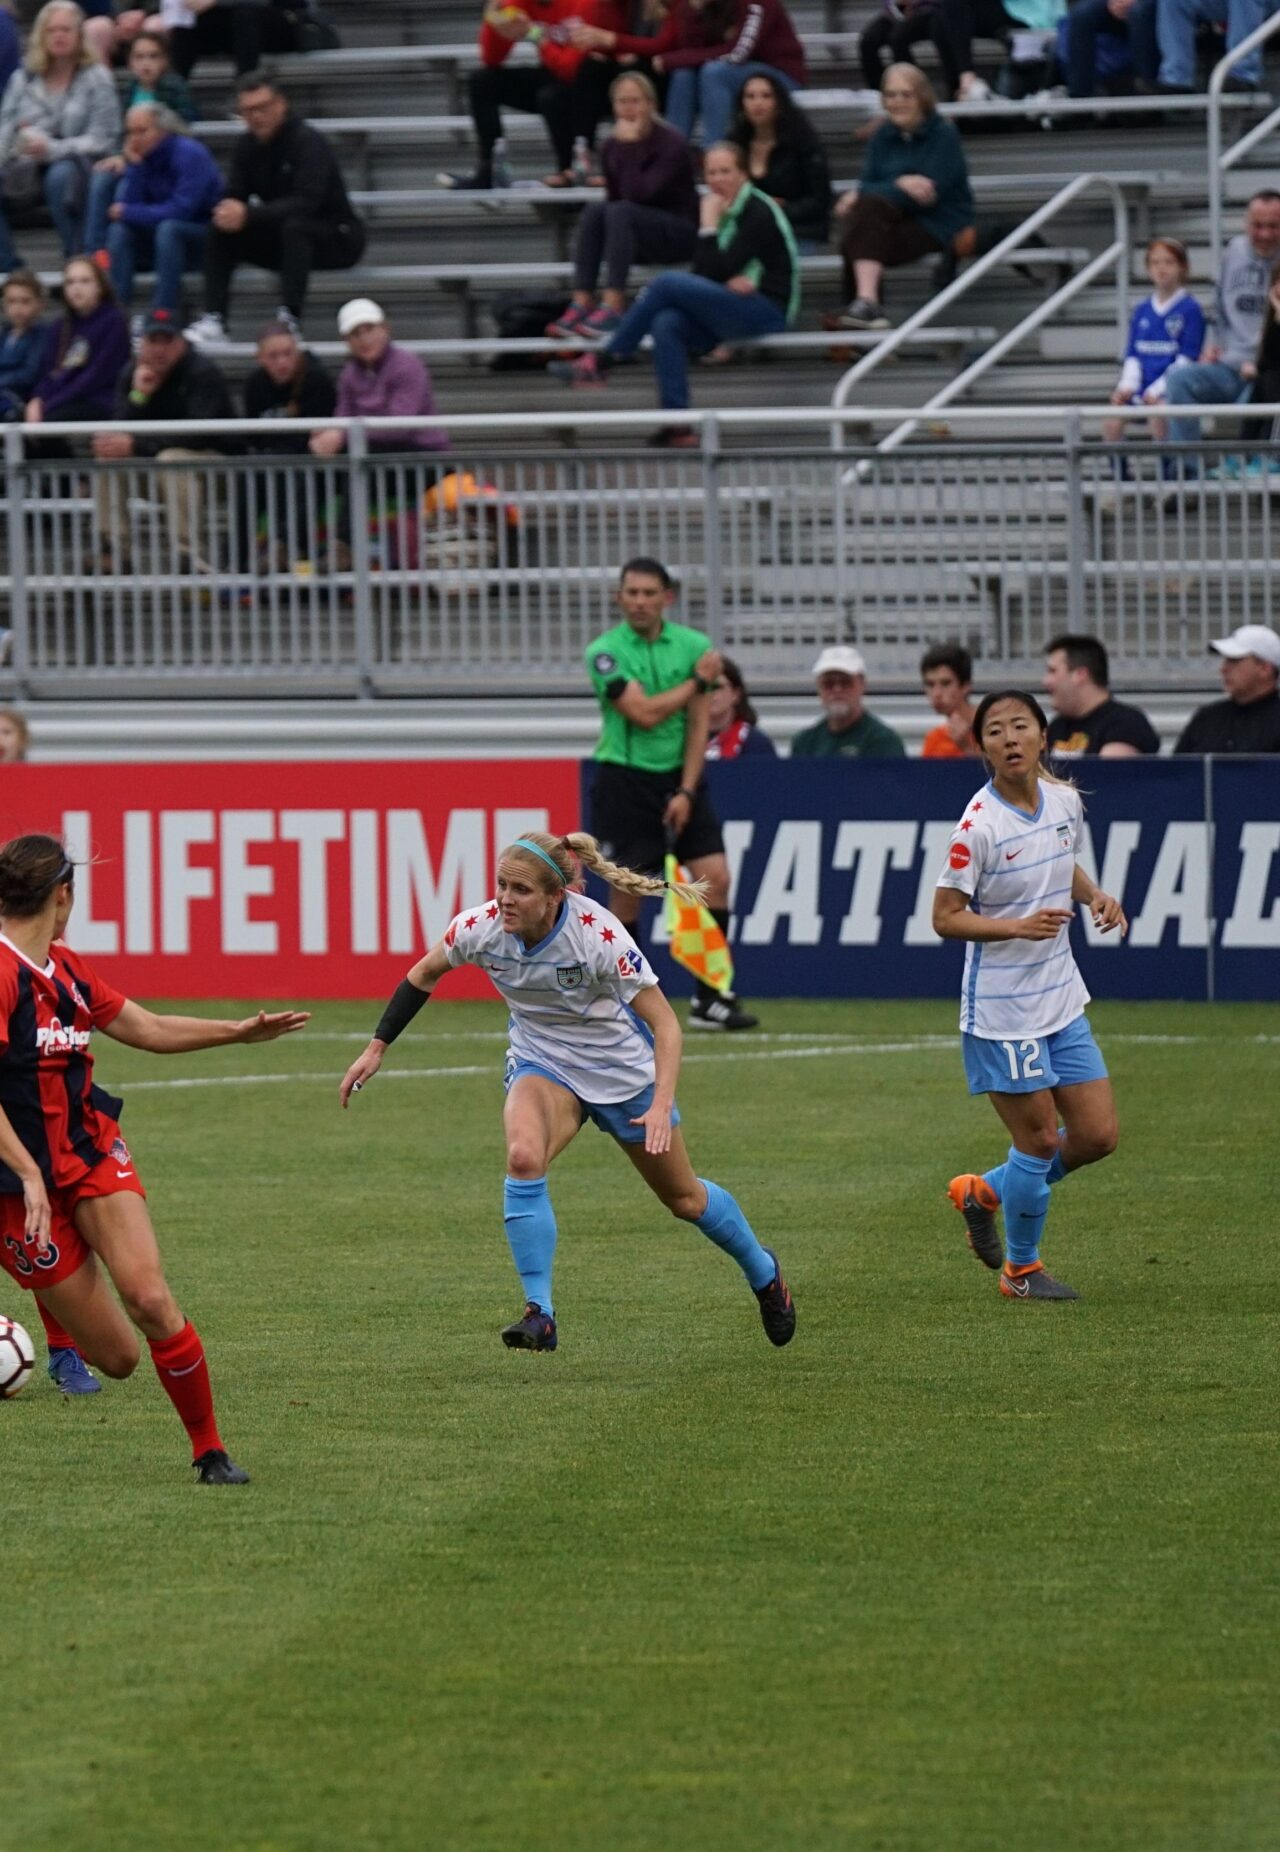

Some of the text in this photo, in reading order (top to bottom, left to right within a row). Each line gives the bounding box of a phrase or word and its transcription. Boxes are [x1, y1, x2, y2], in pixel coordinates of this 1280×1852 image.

[651, 820, 1280, 948] ATINAL
[1002, 1039, 1043, 1080] 12
[4, 1231, 60, 1276] 33
